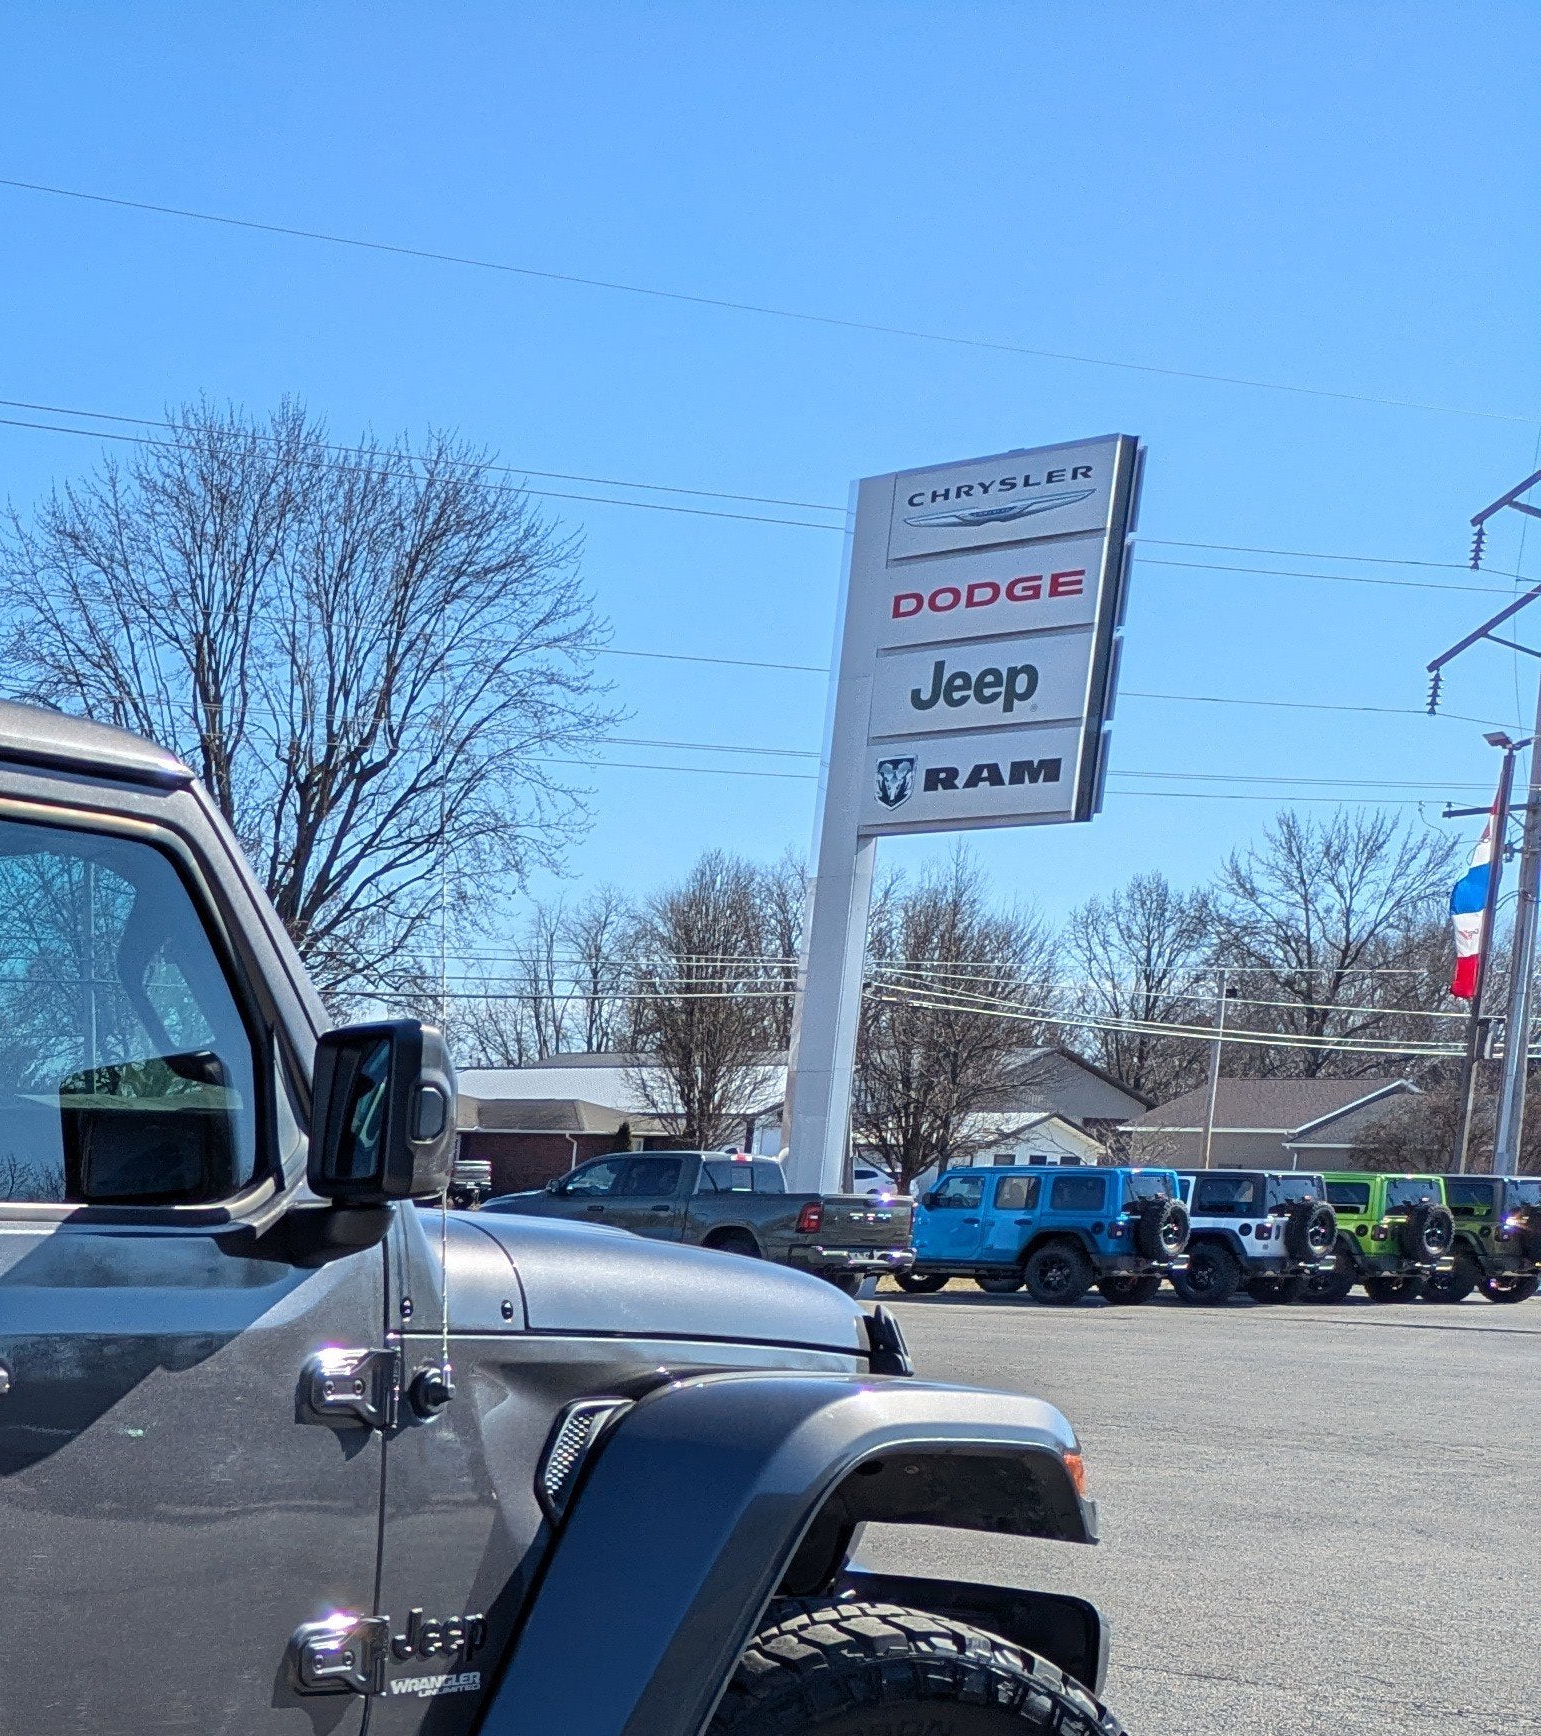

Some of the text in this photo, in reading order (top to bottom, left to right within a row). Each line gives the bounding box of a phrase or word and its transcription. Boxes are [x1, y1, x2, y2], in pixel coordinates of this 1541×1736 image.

[907, 465, 1094, 508] CHRYSLER
[890, 569, 1086, 619] DODGE
[910, 660, 1039, 713] Jeep
[922, 757, 1063, 792] RAM
[391, 1607, 488, 1664] Jeep
[390, 1671, 481, 1695] WRANGLER
[418, 1682, 481, 1698] UNLIMITED
